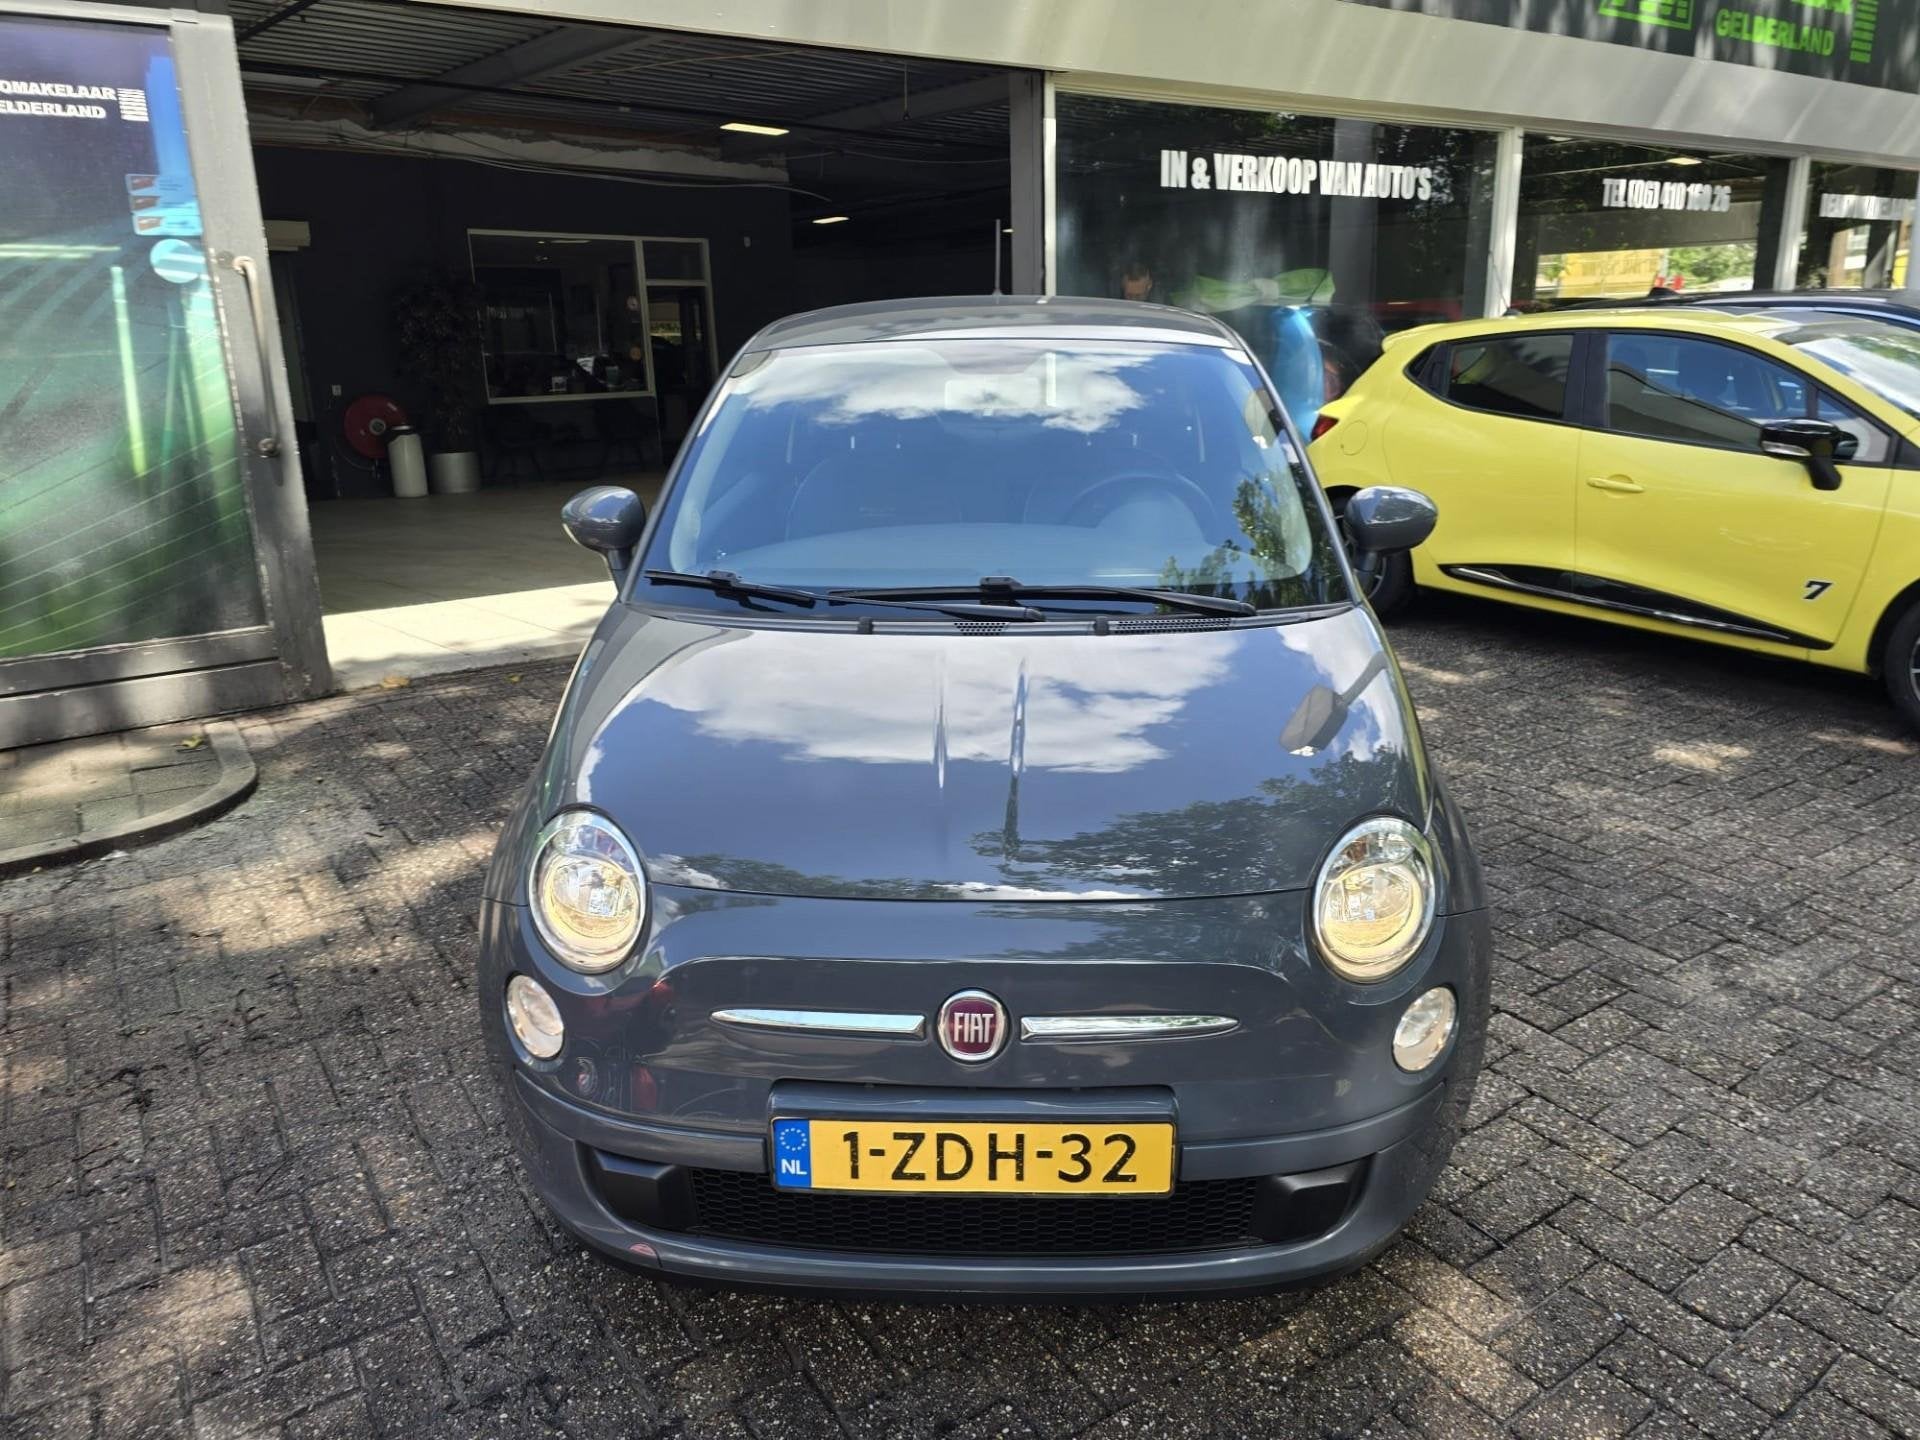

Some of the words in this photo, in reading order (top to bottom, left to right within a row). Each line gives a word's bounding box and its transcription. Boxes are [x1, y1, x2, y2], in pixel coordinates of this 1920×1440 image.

[1715, 8, 1835, 57] GELDERLAND
[1160, 149, 1188, 188] IN
[1191, 157, 1211, 190] &
[1213, 153, 1317, 195] VERKOOP
[1319, 160, 1363, 197] VAN
[1362, 163, 1432, 201] AUTO'S
[1602, 178, 1627, 208] TEL
[1803, 580, 1833, 600] 7
[953, 1012, 995, 1043] FIAT
[781, 1158, 807, 1176] NL
[842, 1131, 1138, 1183] 1-ZDH-32
